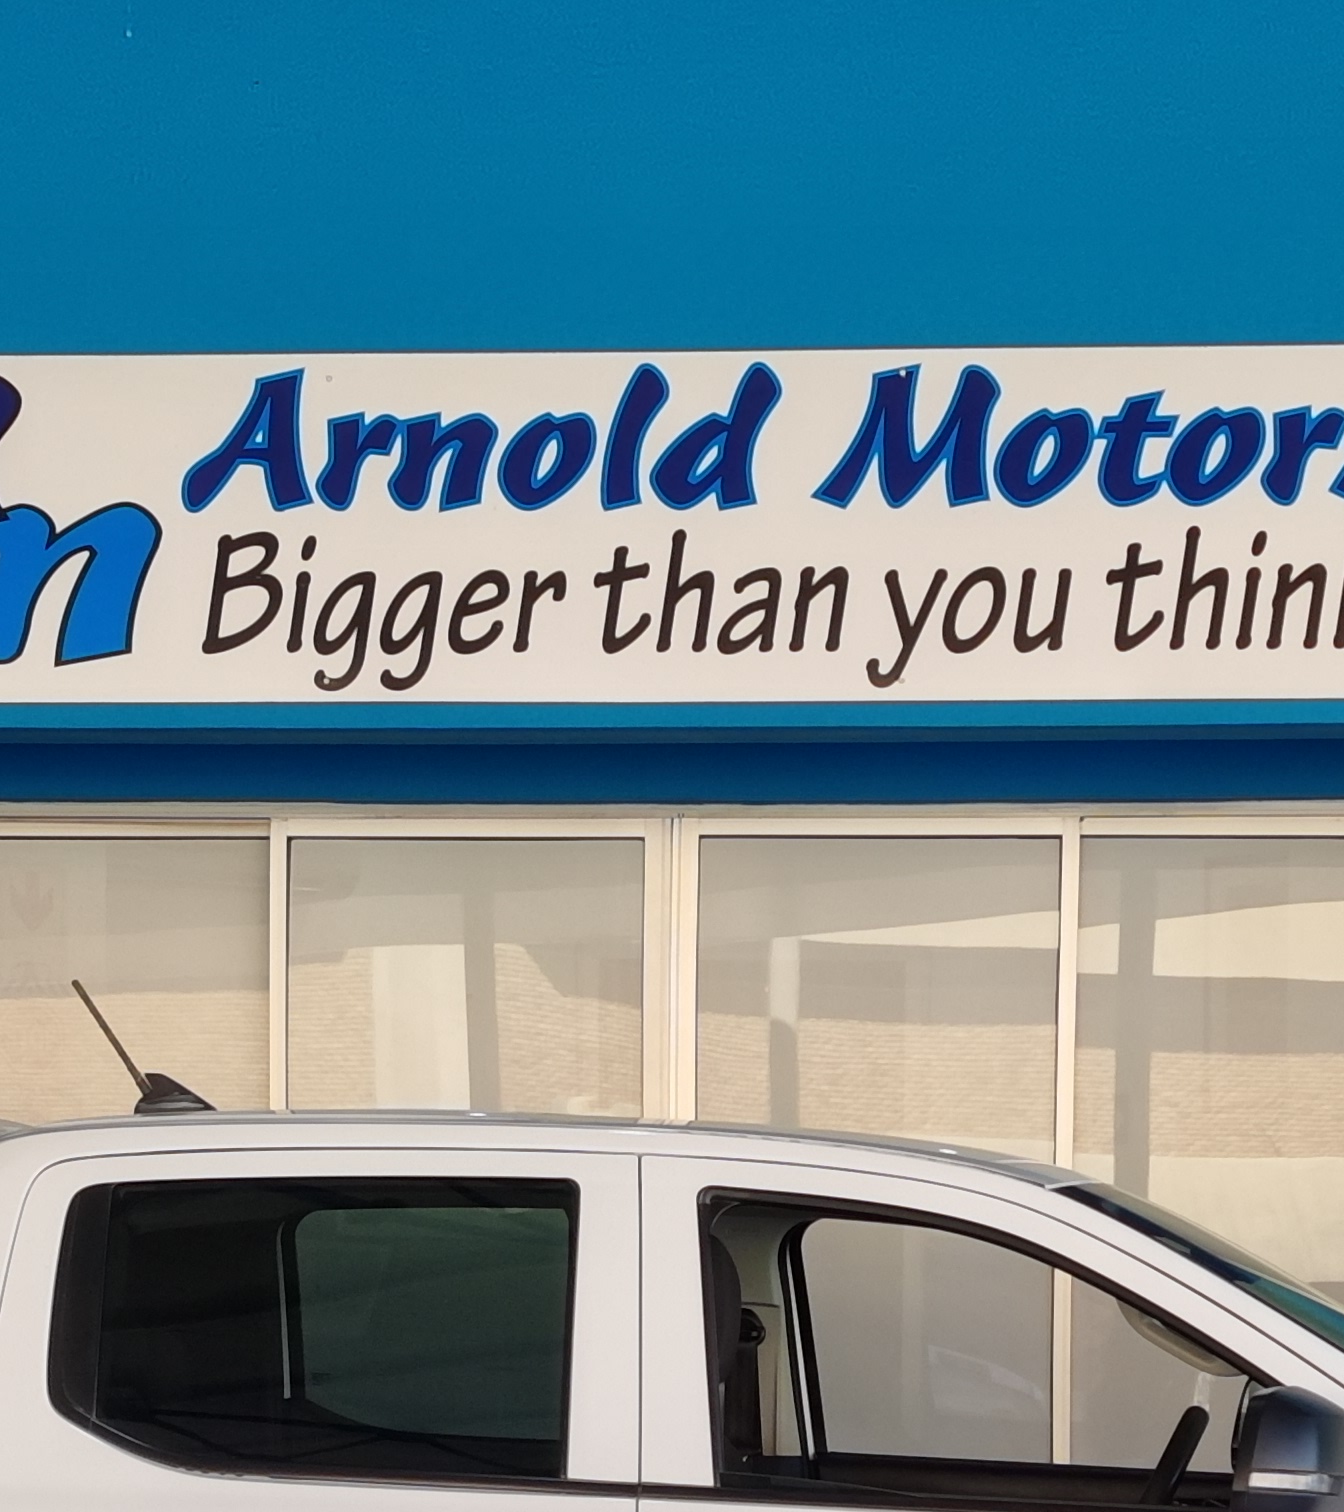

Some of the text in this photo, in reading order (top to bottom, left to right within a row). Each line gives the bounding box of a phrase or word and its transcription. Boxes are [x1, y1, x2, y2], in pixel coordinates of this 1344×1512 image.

[181, 362, 783, 513] Arnold
[202, 531, 567, 692] Bigger
[594, 528, 850, 655] than
[866, 566, 1073, 689] you
